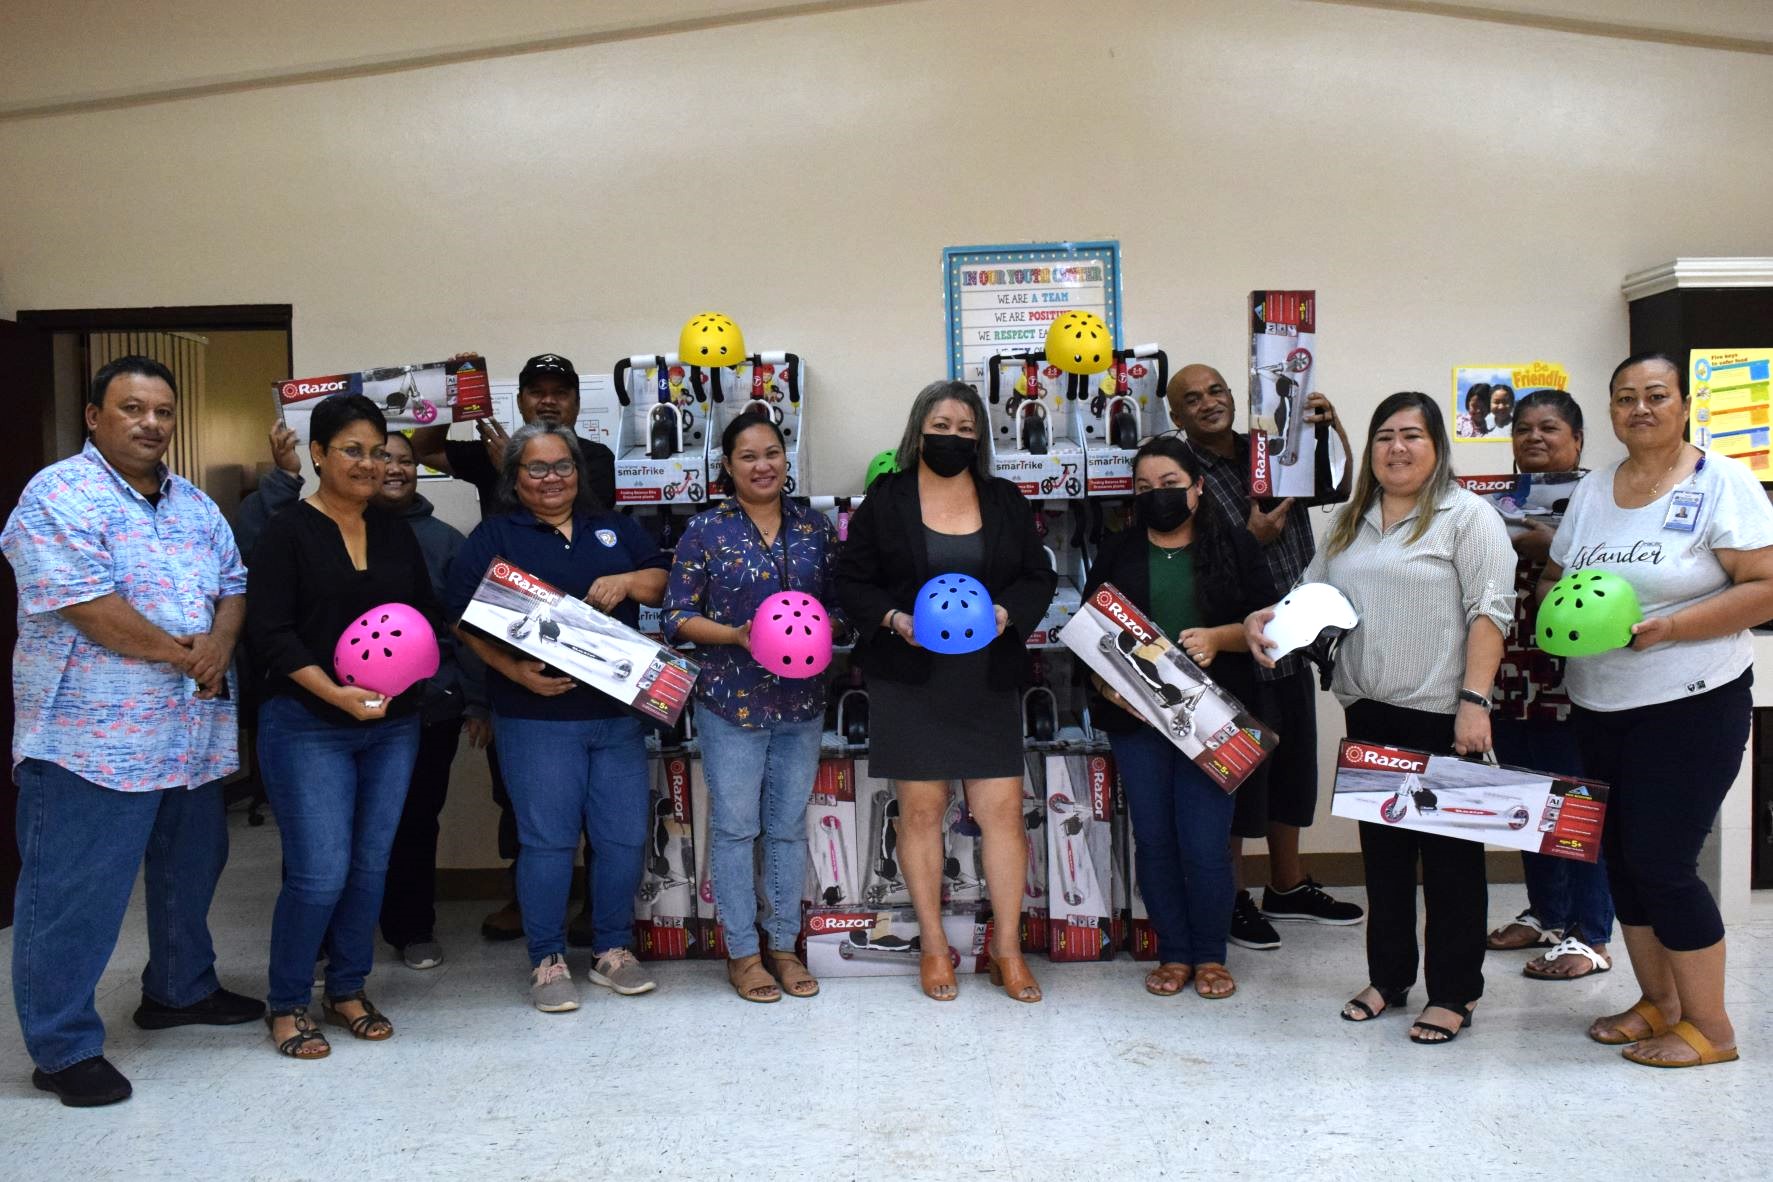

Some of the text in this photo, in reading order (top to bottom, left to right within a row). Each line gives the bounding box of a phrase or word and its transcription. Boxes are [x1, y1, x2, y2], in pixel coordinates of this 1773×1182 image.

[962, 271, 977, 286] IN
[979, 270, 1006, 285] OUR
[1007, 268, 1051, 284] YOUTH
[998, 292, 1069, 304] WE ARE A TEAM
[995, 313, 1008, 322] WE
[1009, 312, 1025, 321] ARE
[978, 331, 991, 341] WE
[994, 329, 1035, 340] RESPECT
[1534, 362, 1549, 372] Be
[1512, 370, 1567, 389] Friendly
[298, 381, 348, 395] Razor
[1089, 456, 1134, 466] smarTrik
[1255, 431, 1266, 479] Razor
[617, 466, 665, 477] smarTrike
[996, 460, 1043, 471] smarTrike
[1466, 480, 1515, 491] Razor
[1570, 539, 1666, 570] Islander
[508, 572, 559, 602] Razor
[1108, 602, 1152, 641] Razor
[1364, 750, 1424, 771] Razor
[672, 775, 684, 821] Razor
[1093, 772, 1105, 819] Razor
[1571, 840, 1582, 848] 5+
[825, 917, 874, 929] Razor
